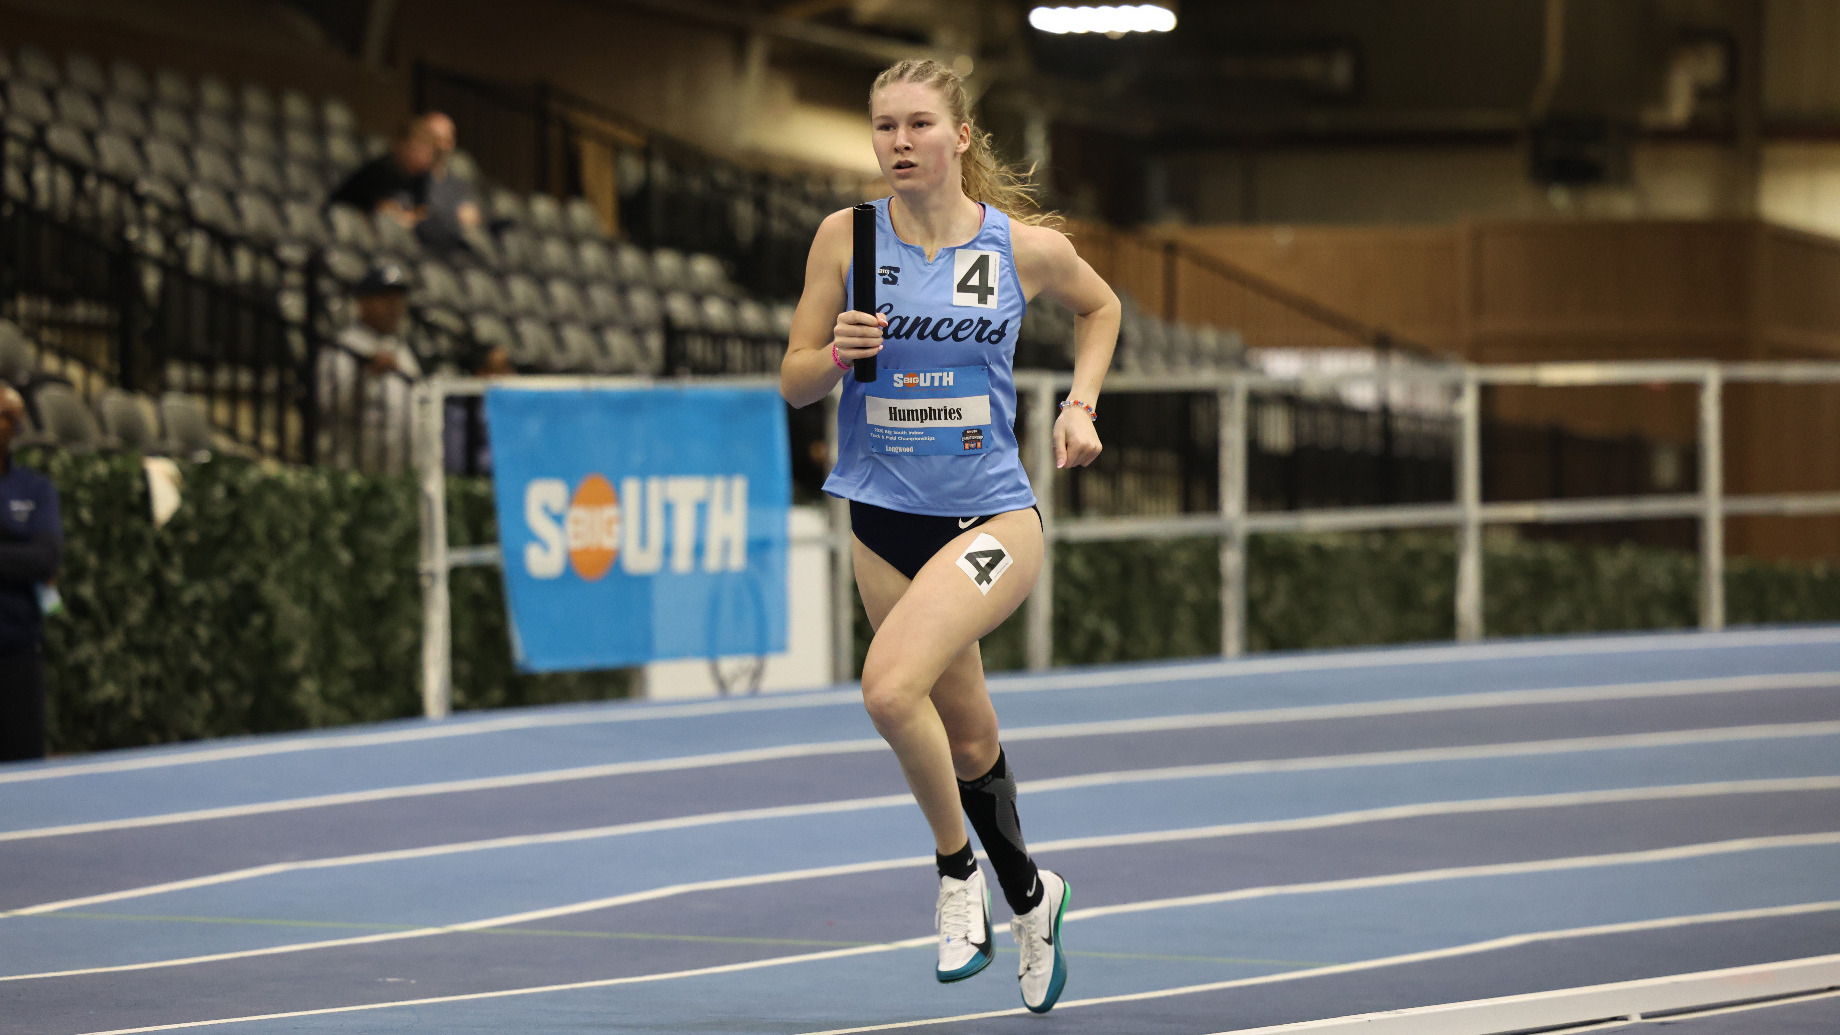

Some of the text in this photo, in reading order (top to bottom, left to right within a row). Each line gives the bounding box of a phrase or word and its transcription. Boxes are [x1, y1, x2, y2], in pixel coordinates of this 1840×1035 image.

[956, 254, 995, 305] 4
[893, 371, 954, 388] SOUTH
[888, 405, 962, 423] Humphries
[885, 445, 913, 453] Longwood
[525, 473, 748, 581] SOUTH
[566, 505, 620, 550] BIG
[964, 548, 1006, 586] 4
